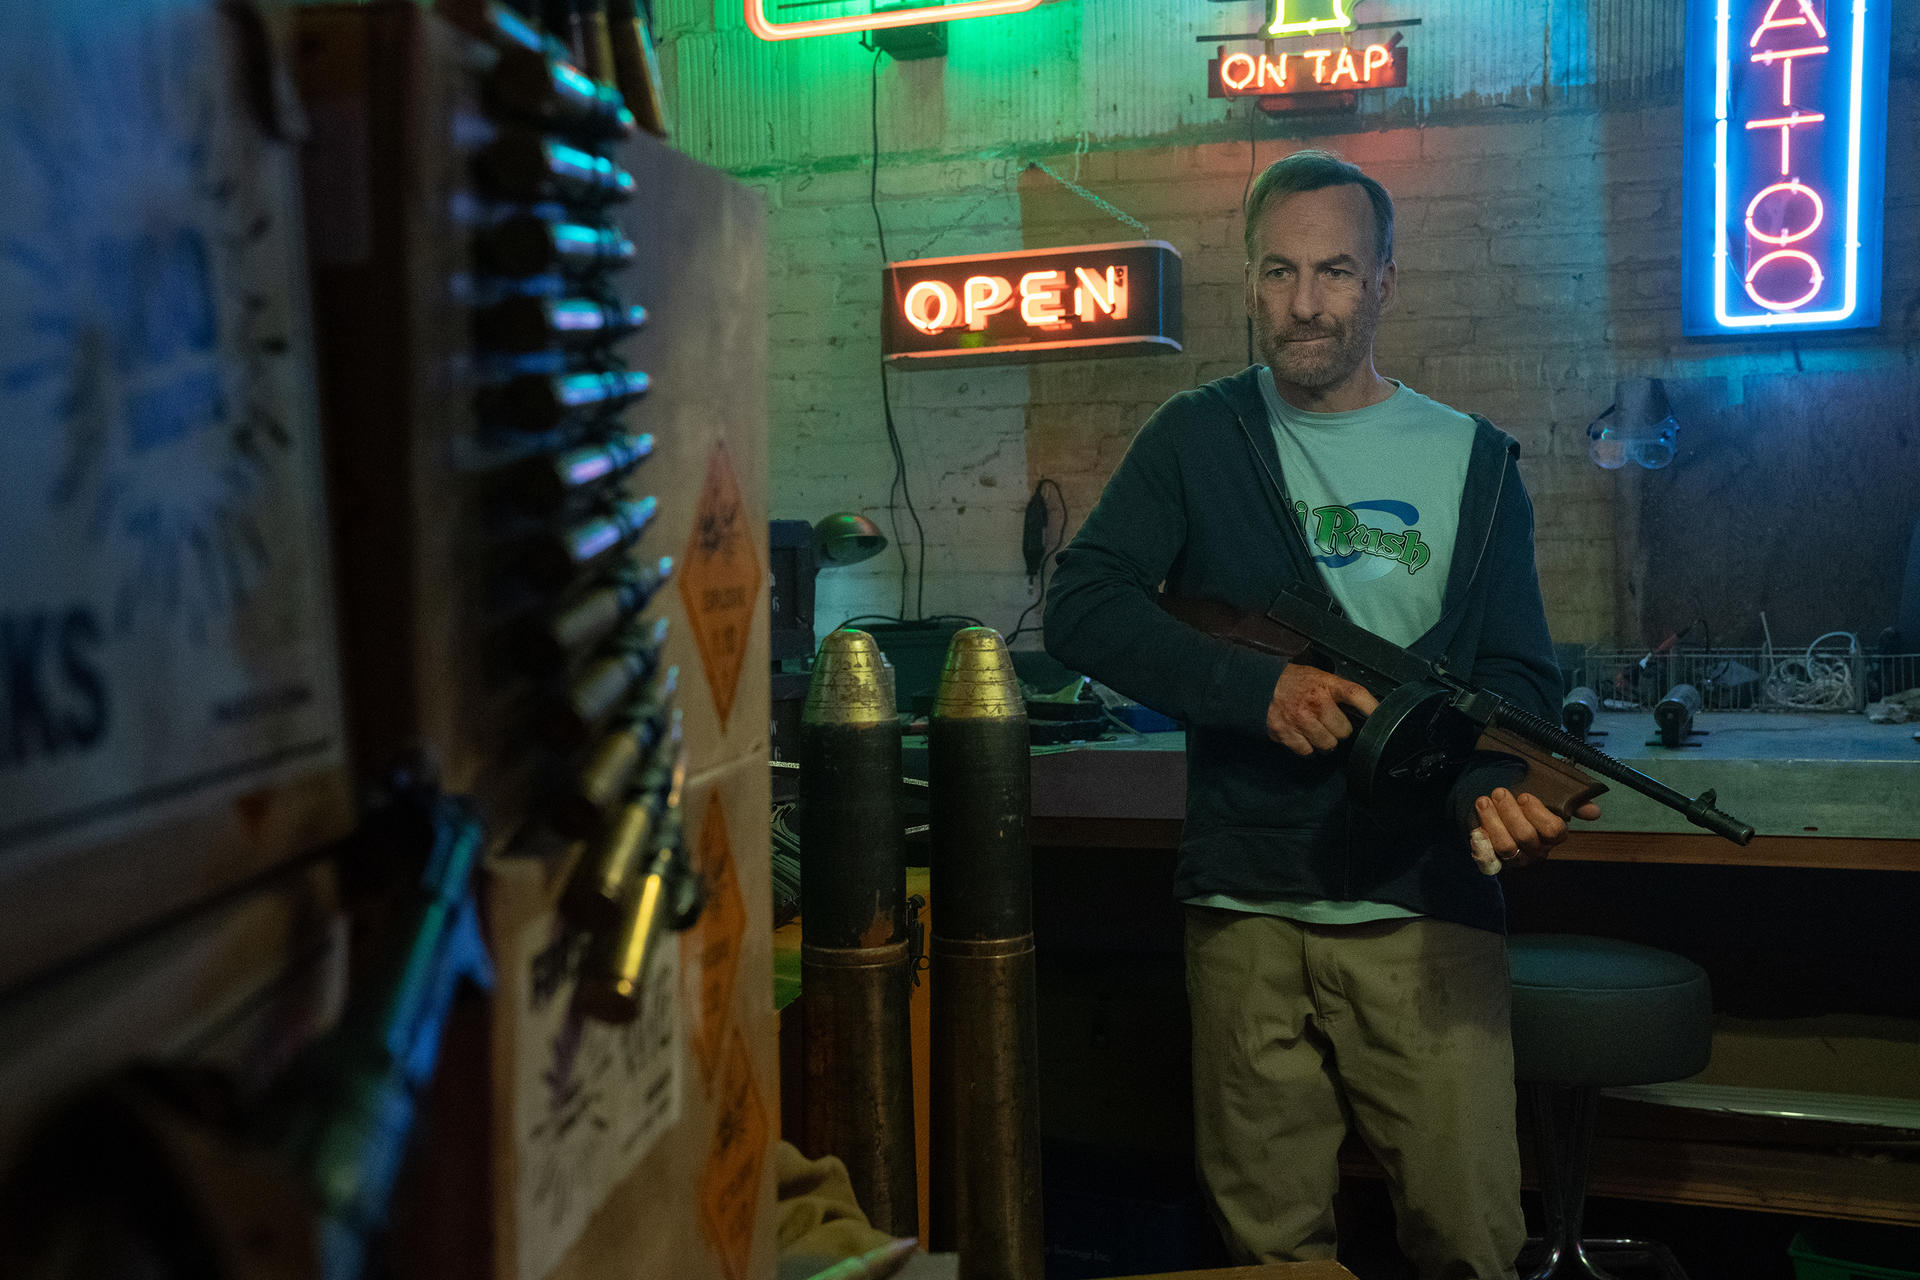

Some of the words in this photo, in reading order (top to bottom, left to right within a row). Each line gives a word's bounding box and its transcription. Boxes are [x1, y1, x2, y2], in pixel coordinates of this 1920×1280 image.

[1221, 52, 1288, 90] ON
[1303, 44, 1390, 84] TAP
[1745, 0, 1829, 311] ATTOO
[904, 264, 1129, 334] OPEN
[1313, 505, 1430, 575] Rush
